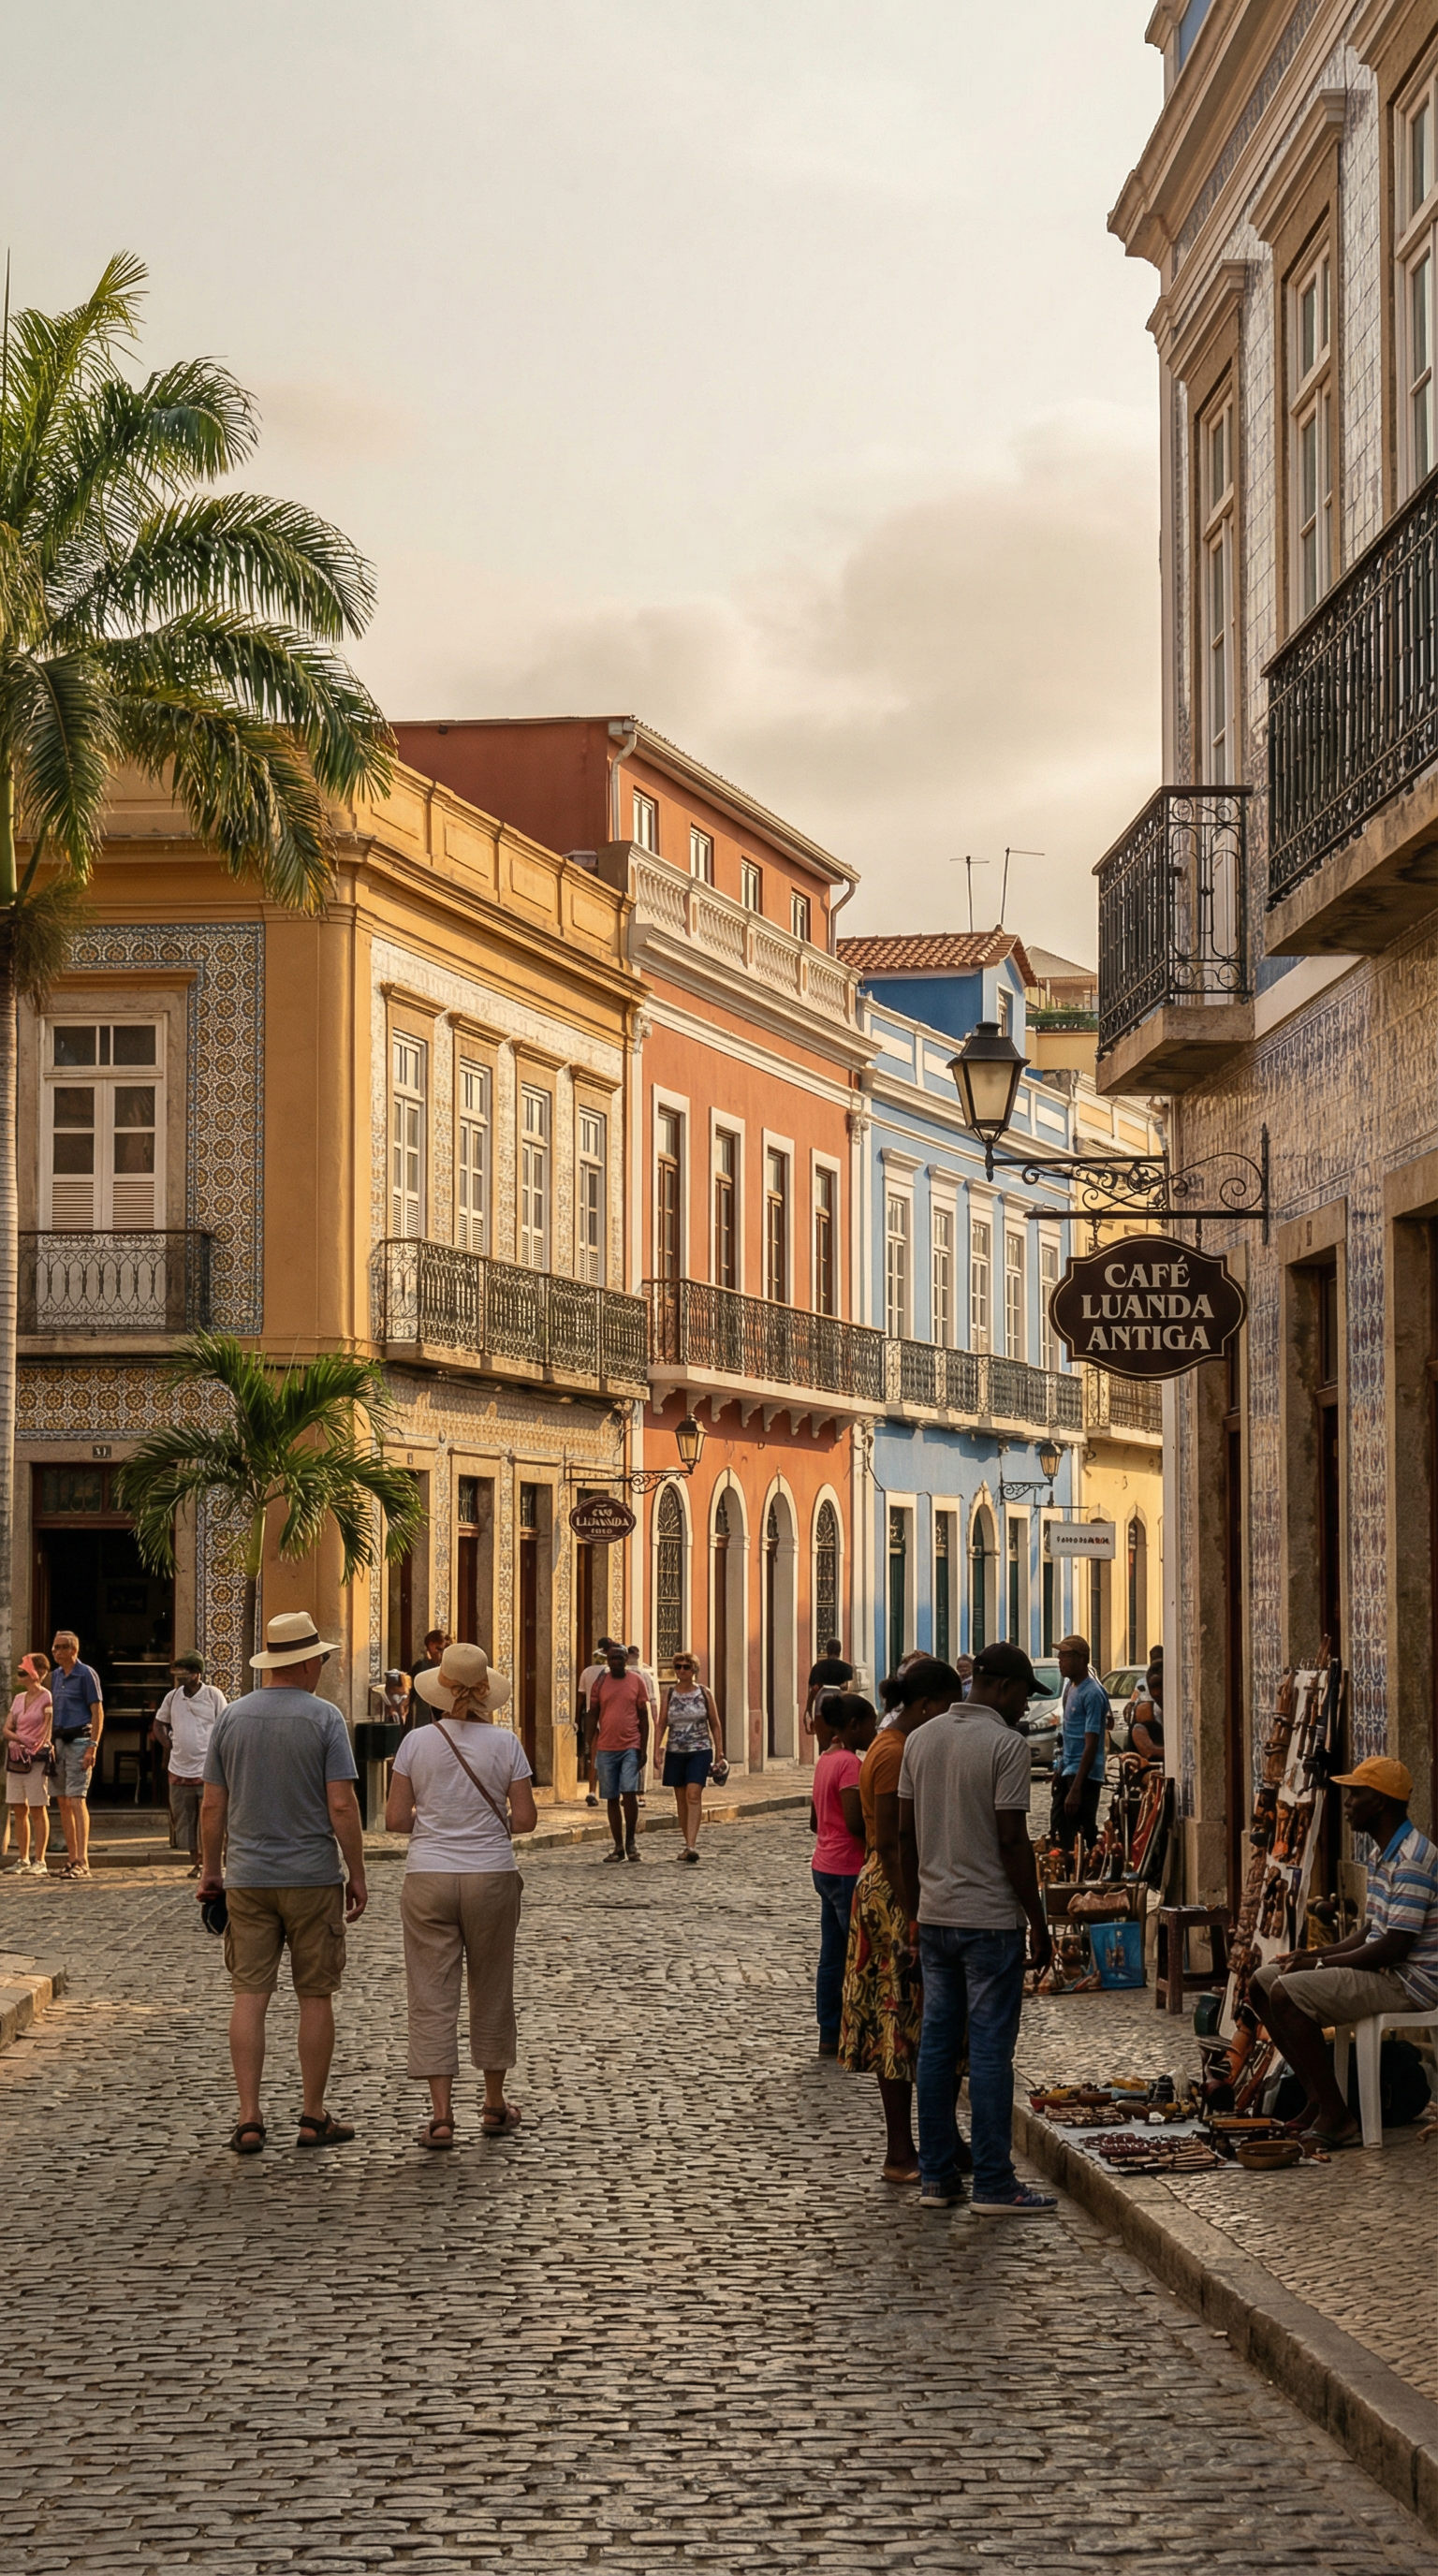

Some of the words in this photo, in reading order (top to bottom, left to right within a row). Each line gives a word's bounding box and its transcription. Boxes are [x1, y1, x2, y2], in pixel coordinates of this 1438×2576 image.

[1104, 1254, 1191, 1288] CAFÉ
[1081, 1294, 1215, 1319] LUANDA
[1085, 1325, 1211, 1351] ANTIGA
